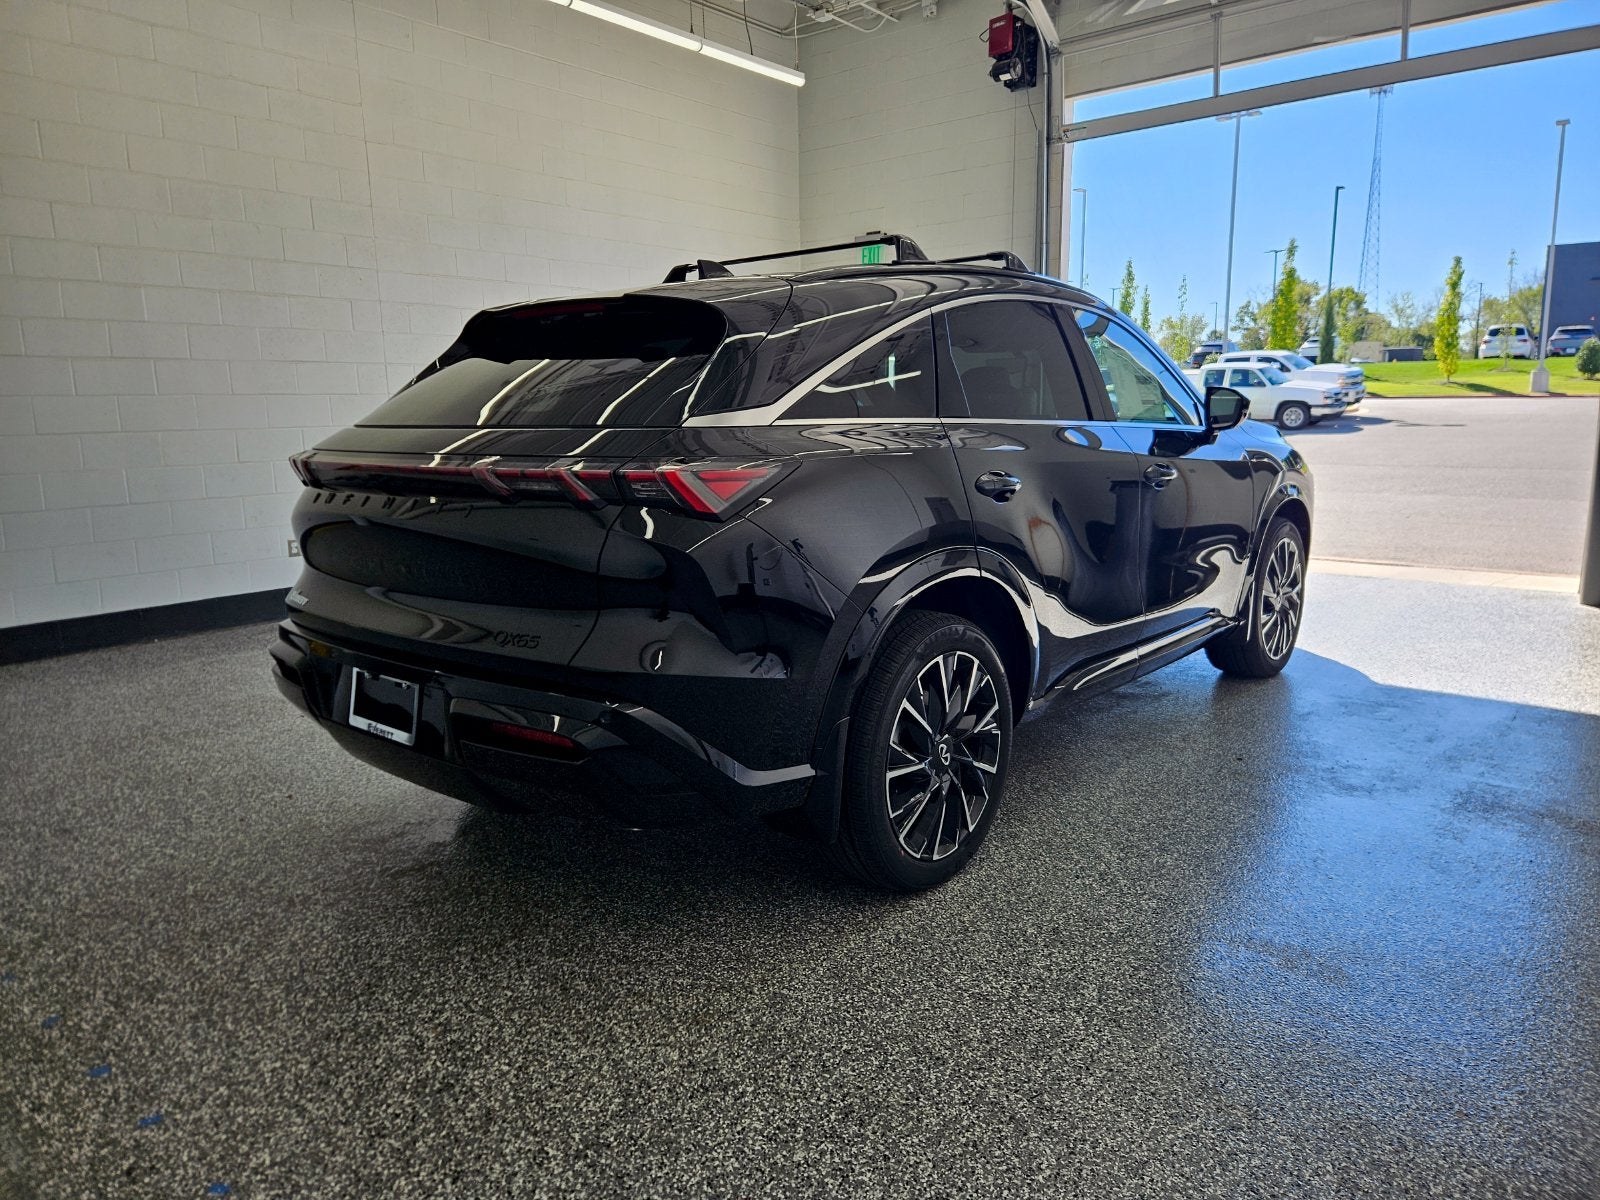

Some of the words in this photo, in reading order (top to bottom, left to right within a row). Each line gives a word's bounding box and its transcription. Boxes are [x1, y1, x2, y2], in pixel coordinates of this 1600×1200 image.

[862, 246, 881, 264] EXIT
[313, 492, 474, 518] INFINITI
[494, 630, 542, 649] QX65
